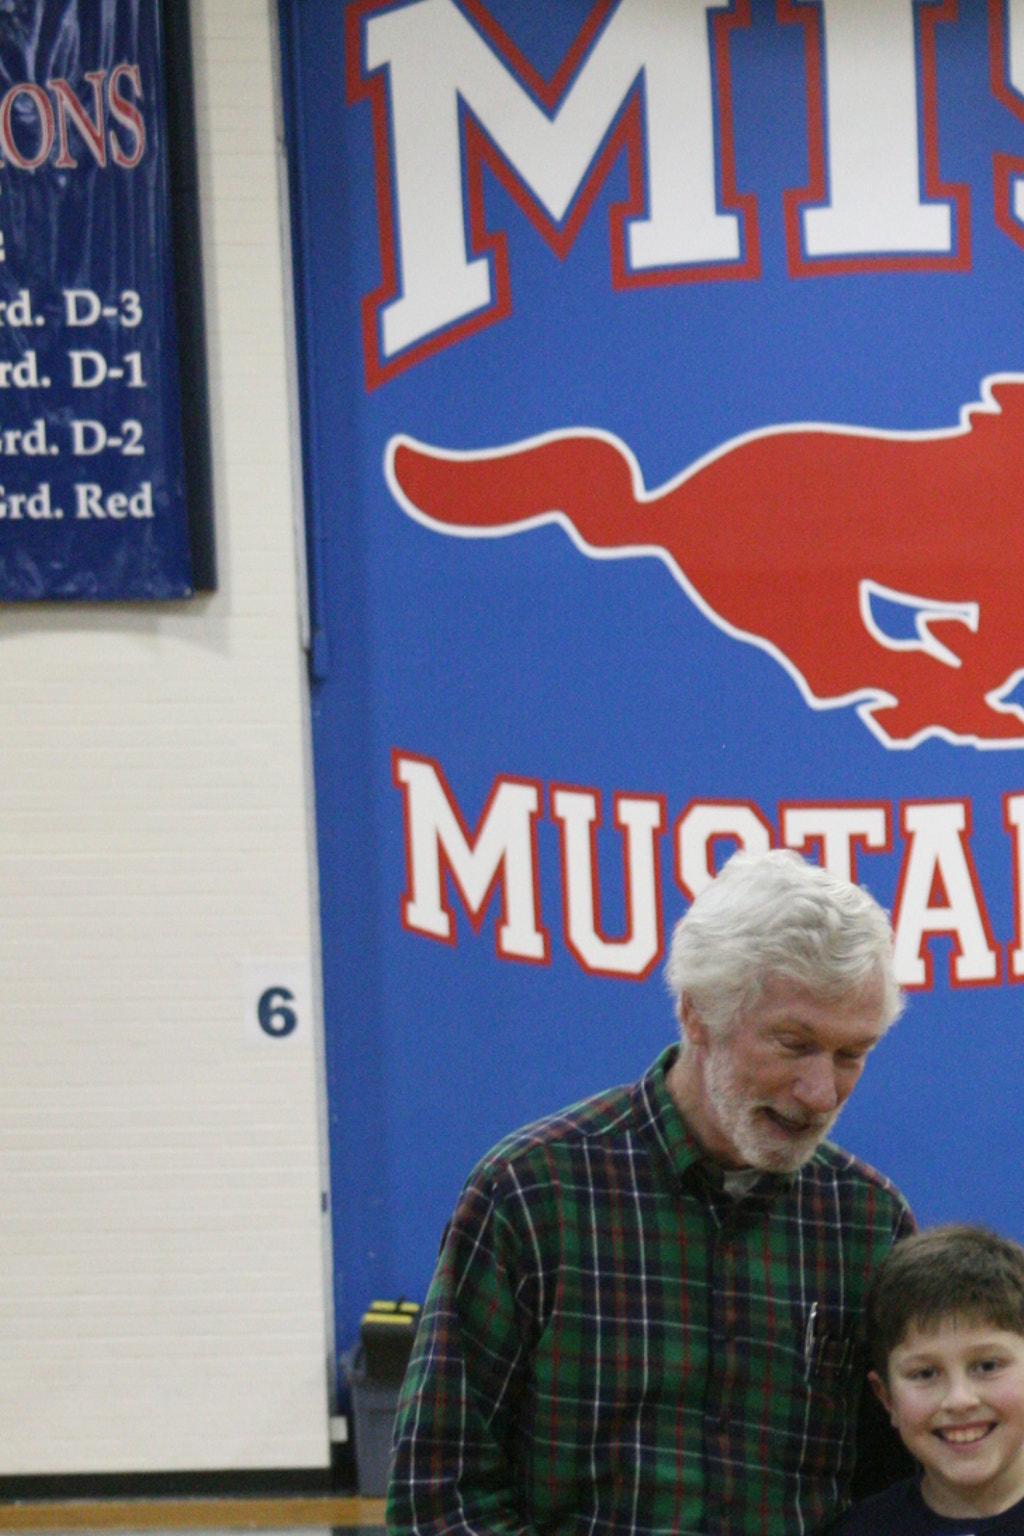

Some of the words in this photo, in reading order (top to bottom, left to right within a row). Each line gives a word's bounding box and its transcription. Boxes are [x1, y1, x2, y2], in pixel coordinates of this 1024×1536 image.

[0, 65, 146, 168] ONS
[0, 290, 46, 327] rd.
[64, 290, 143, 327] D-3
[0, 352, 51, 388] rd.
[70, 351, 146, 387] D-1
[0, 420, 59, 456] rd.
[72, 420, 146, 455] D-2
[75, 482, 154, 518] Red
[257, 985, 297, 1038] 6
